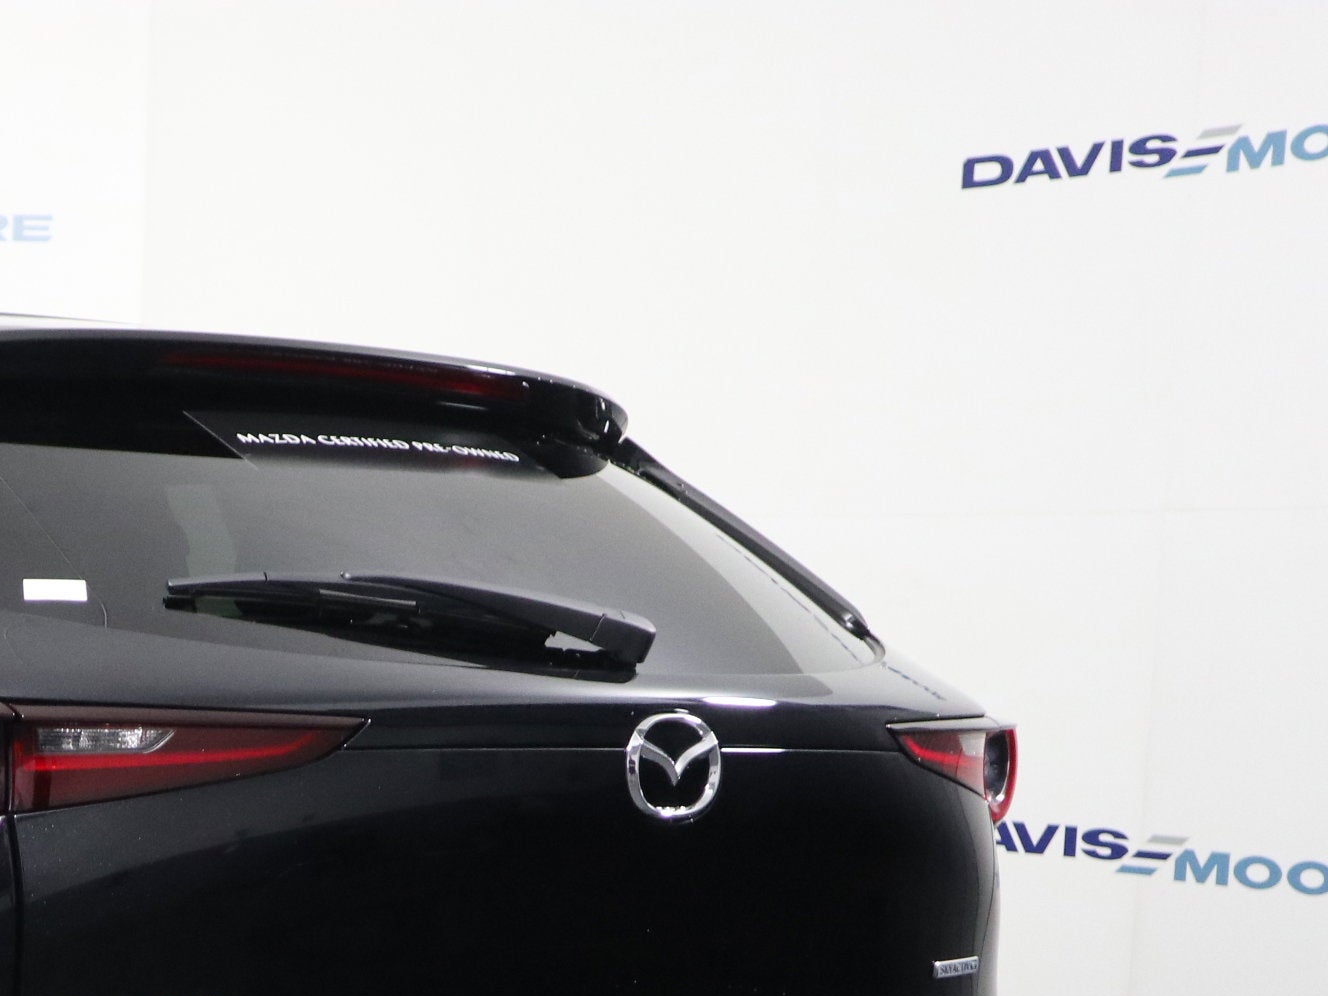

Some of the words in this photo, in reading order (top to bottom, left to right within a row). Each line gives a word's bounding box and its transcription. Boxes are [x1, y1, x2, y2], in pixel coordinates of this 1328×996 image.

[961, 133, 1179, 189] DAVIS
[236, 432, 317, 445] MAZDA
[317, 434, 410, 450] CERTIFIED
[411, 440, 520, 462] PRE-OWNED
